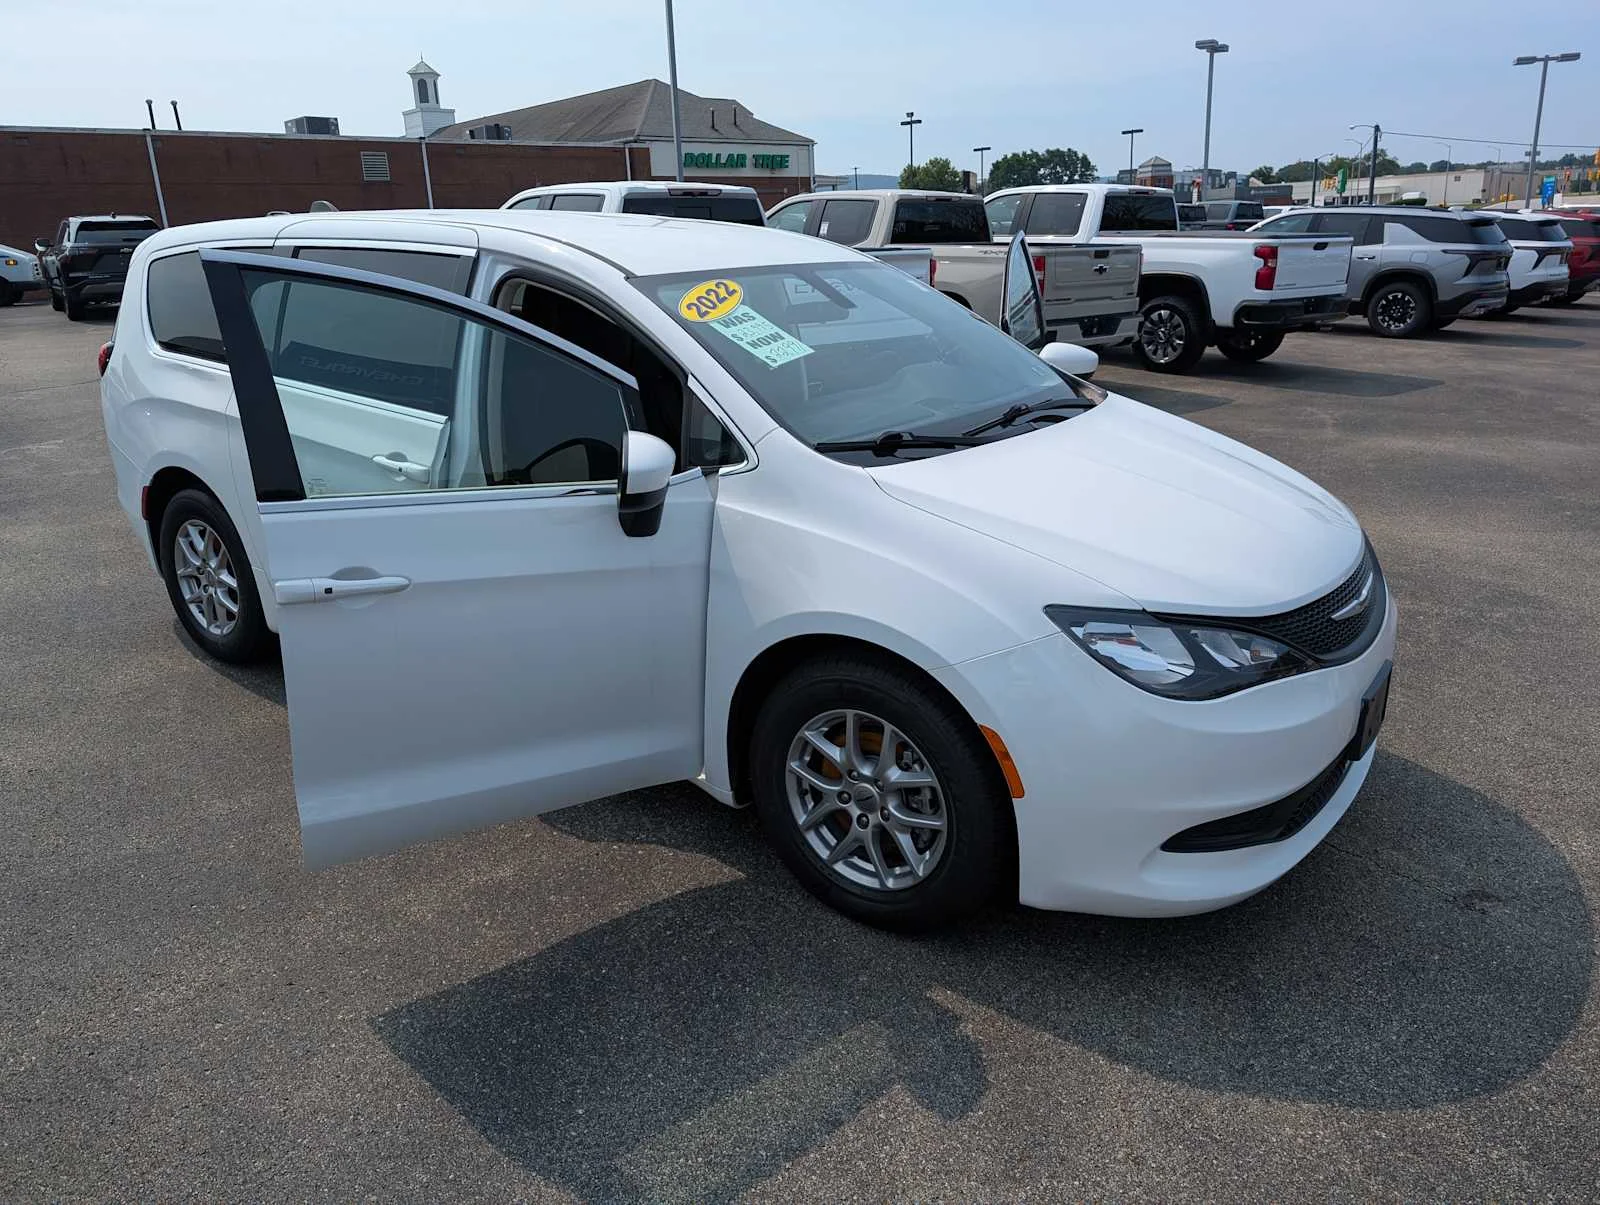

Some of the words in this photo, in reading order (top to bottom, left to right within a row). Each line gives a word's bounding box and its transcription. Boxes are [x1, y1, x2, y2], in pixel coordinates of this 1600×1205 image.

[684, 152, 747, 169] DOLLAR
[753, 154, 790, 169] TREE
[686, 281, 738, 319] 2022
[716, 312, 756, 328] WAS
[745, 331, 786, 349] NOW
